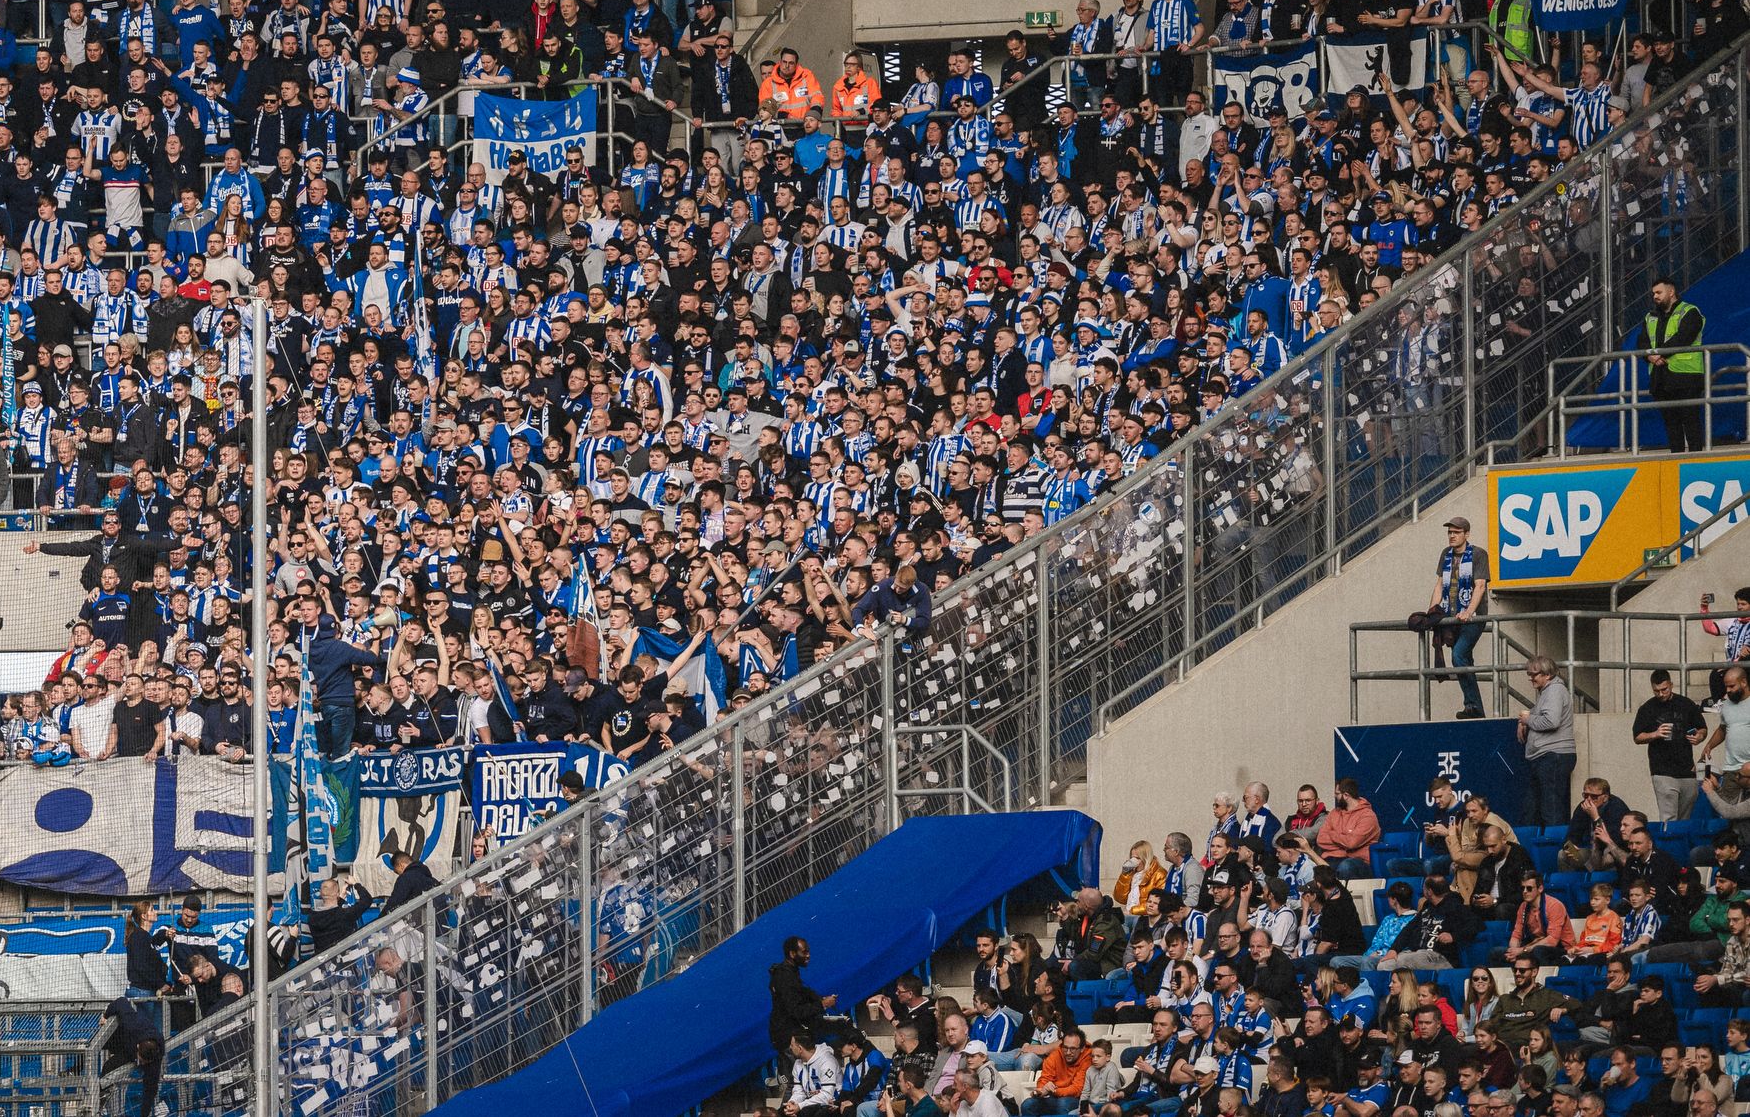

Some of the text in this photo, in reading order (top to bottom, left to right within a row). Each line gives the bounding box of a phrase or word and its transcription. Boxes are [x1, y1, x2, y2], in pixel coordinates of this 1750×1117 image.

[1292, 301, 1303, 311] DB
[1498, 489, 1603, 562] SAP
[482, 758, 563, 801] RAGAZZ
